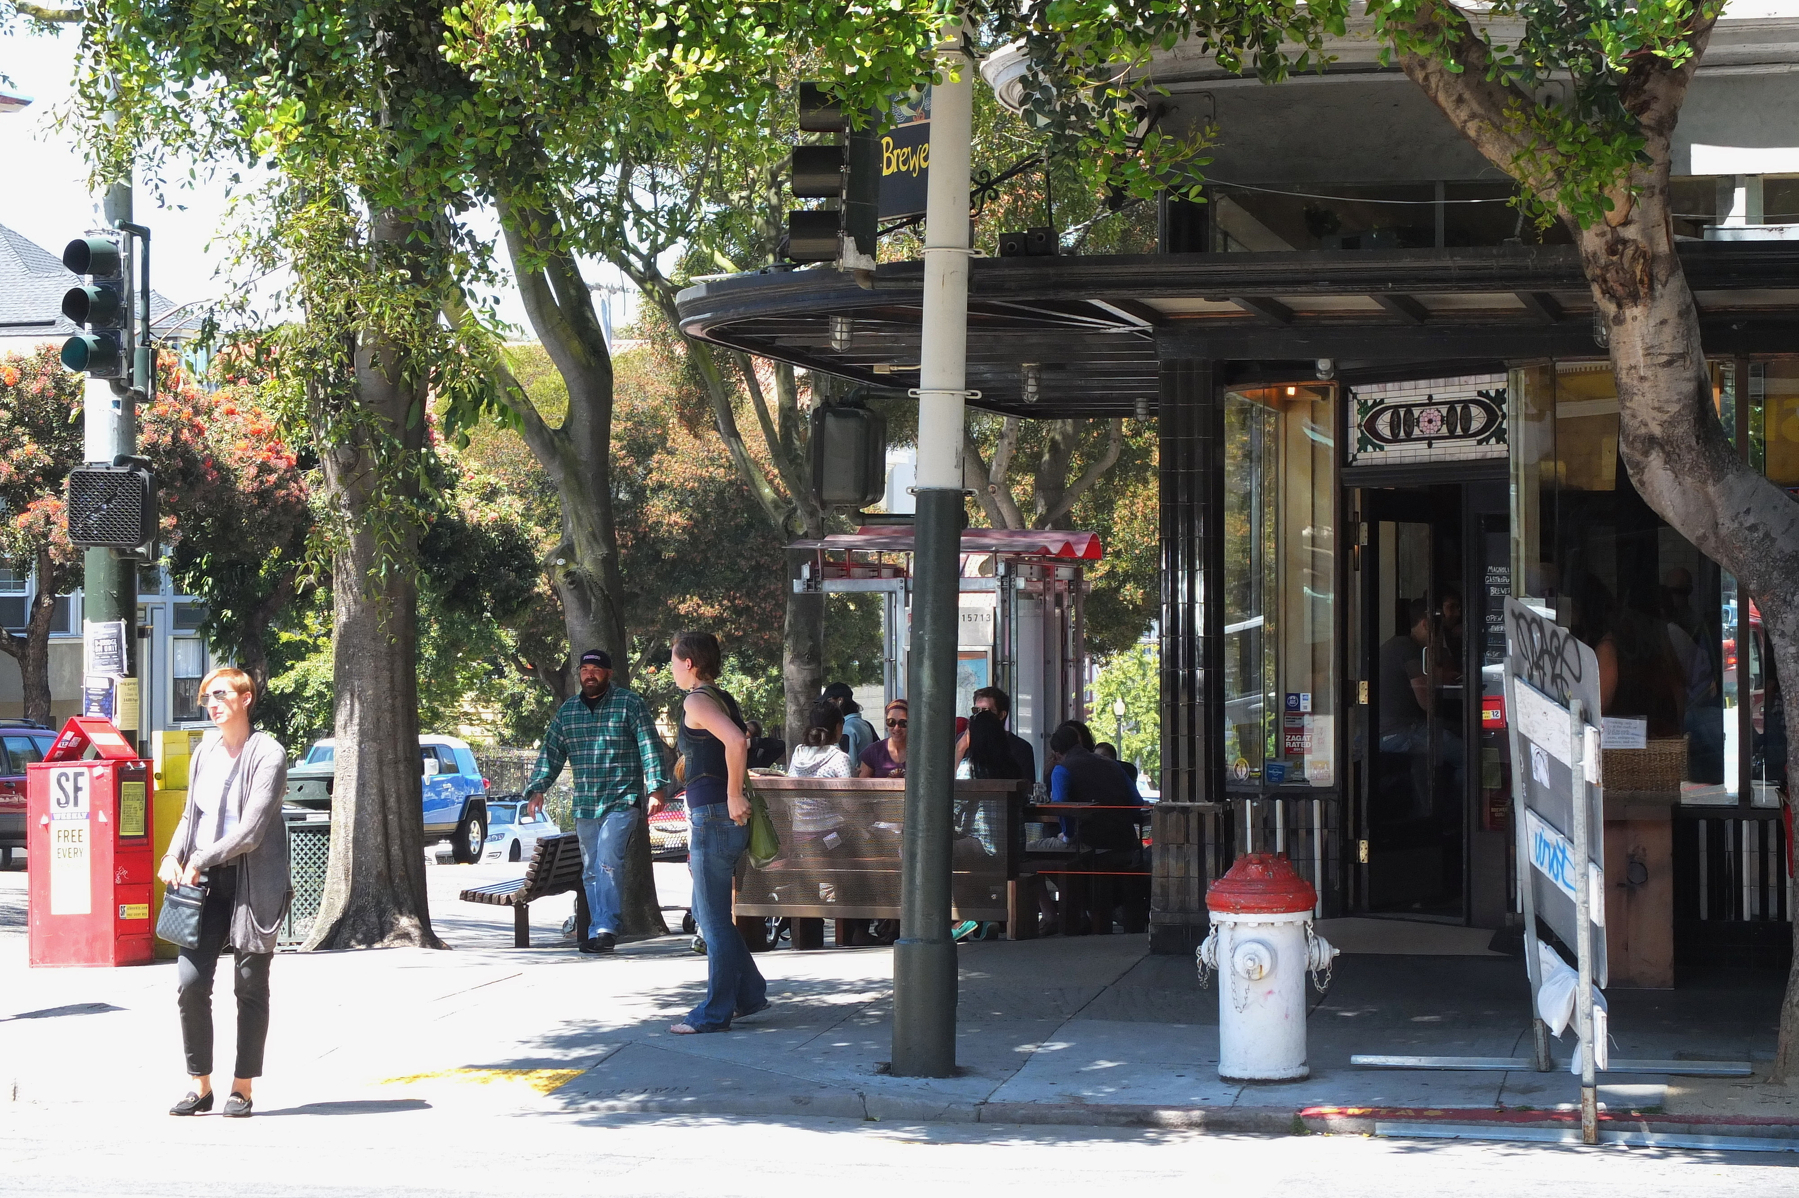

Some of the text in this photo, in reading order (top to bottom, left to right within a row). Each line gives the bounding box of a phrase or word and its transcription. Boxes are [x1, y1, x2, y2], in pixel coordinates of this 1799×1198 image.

[961, 613, 991, 622] 15713
[1485, 614, 1504, 622] OPEN
[56, 771, 85, 809] SF
[57, 829, 84, 843] FREE
[57, 847, 84, 859] EVERY
